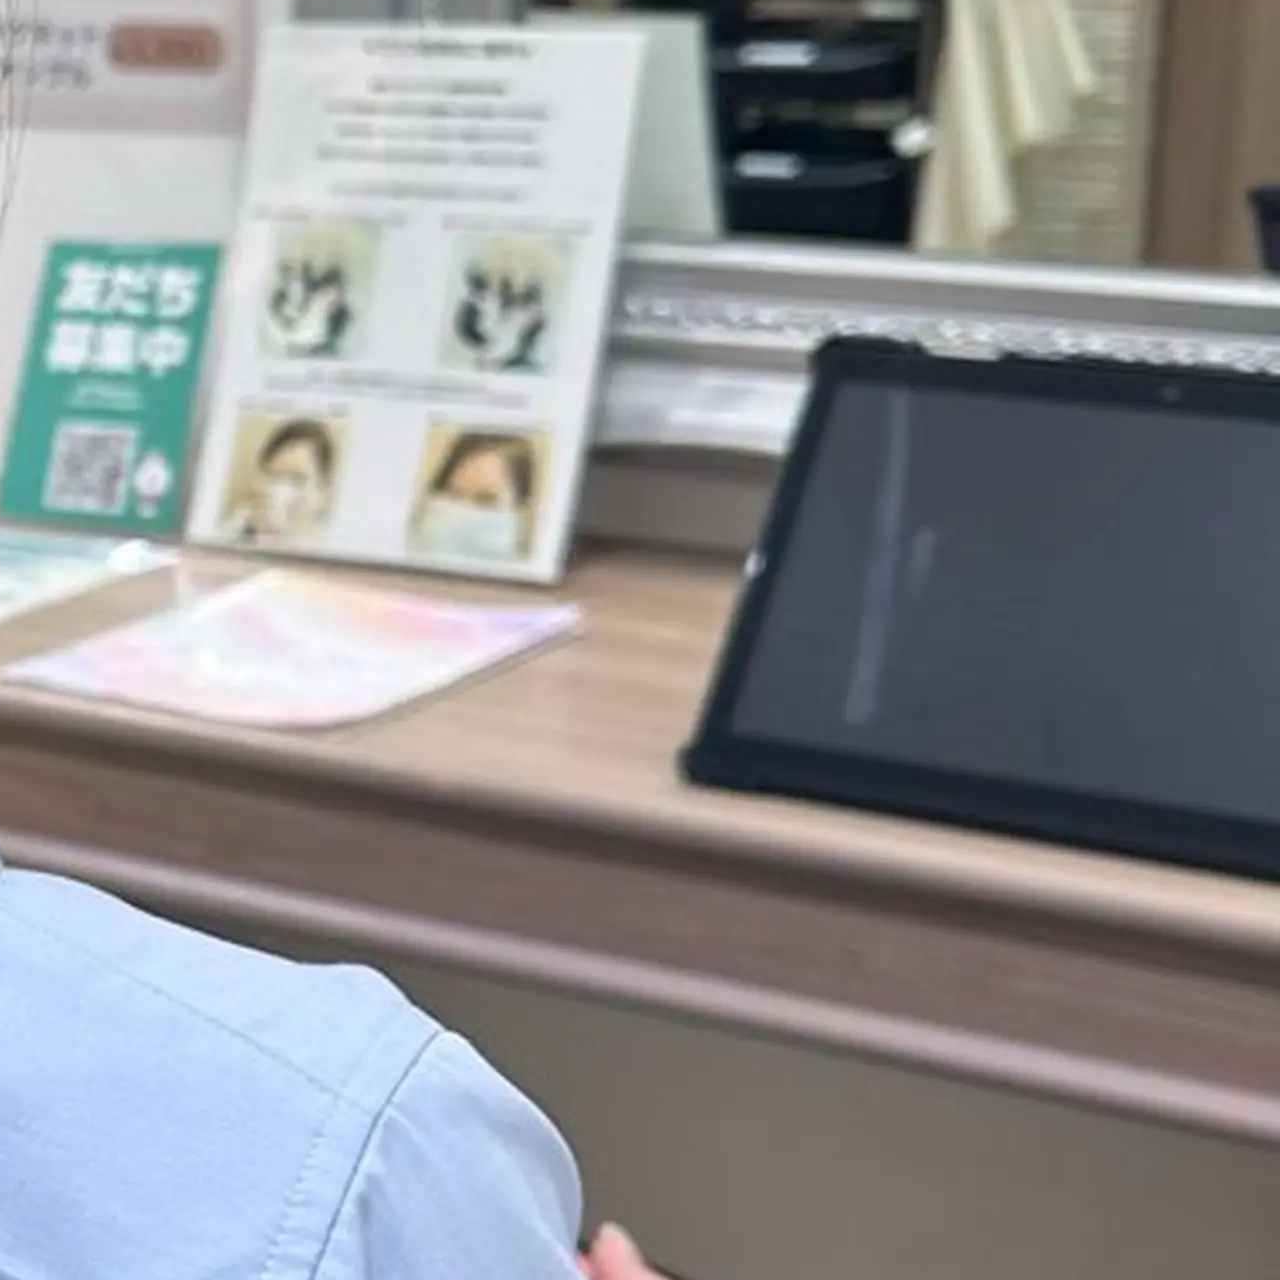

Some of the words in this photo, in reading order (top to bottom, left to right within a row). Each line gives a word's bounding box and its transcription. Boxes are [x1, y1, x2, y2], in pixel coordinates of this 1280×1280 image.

[56, 260, 205, 320] 友だち
[44, 322, 192, 380] 募集中
